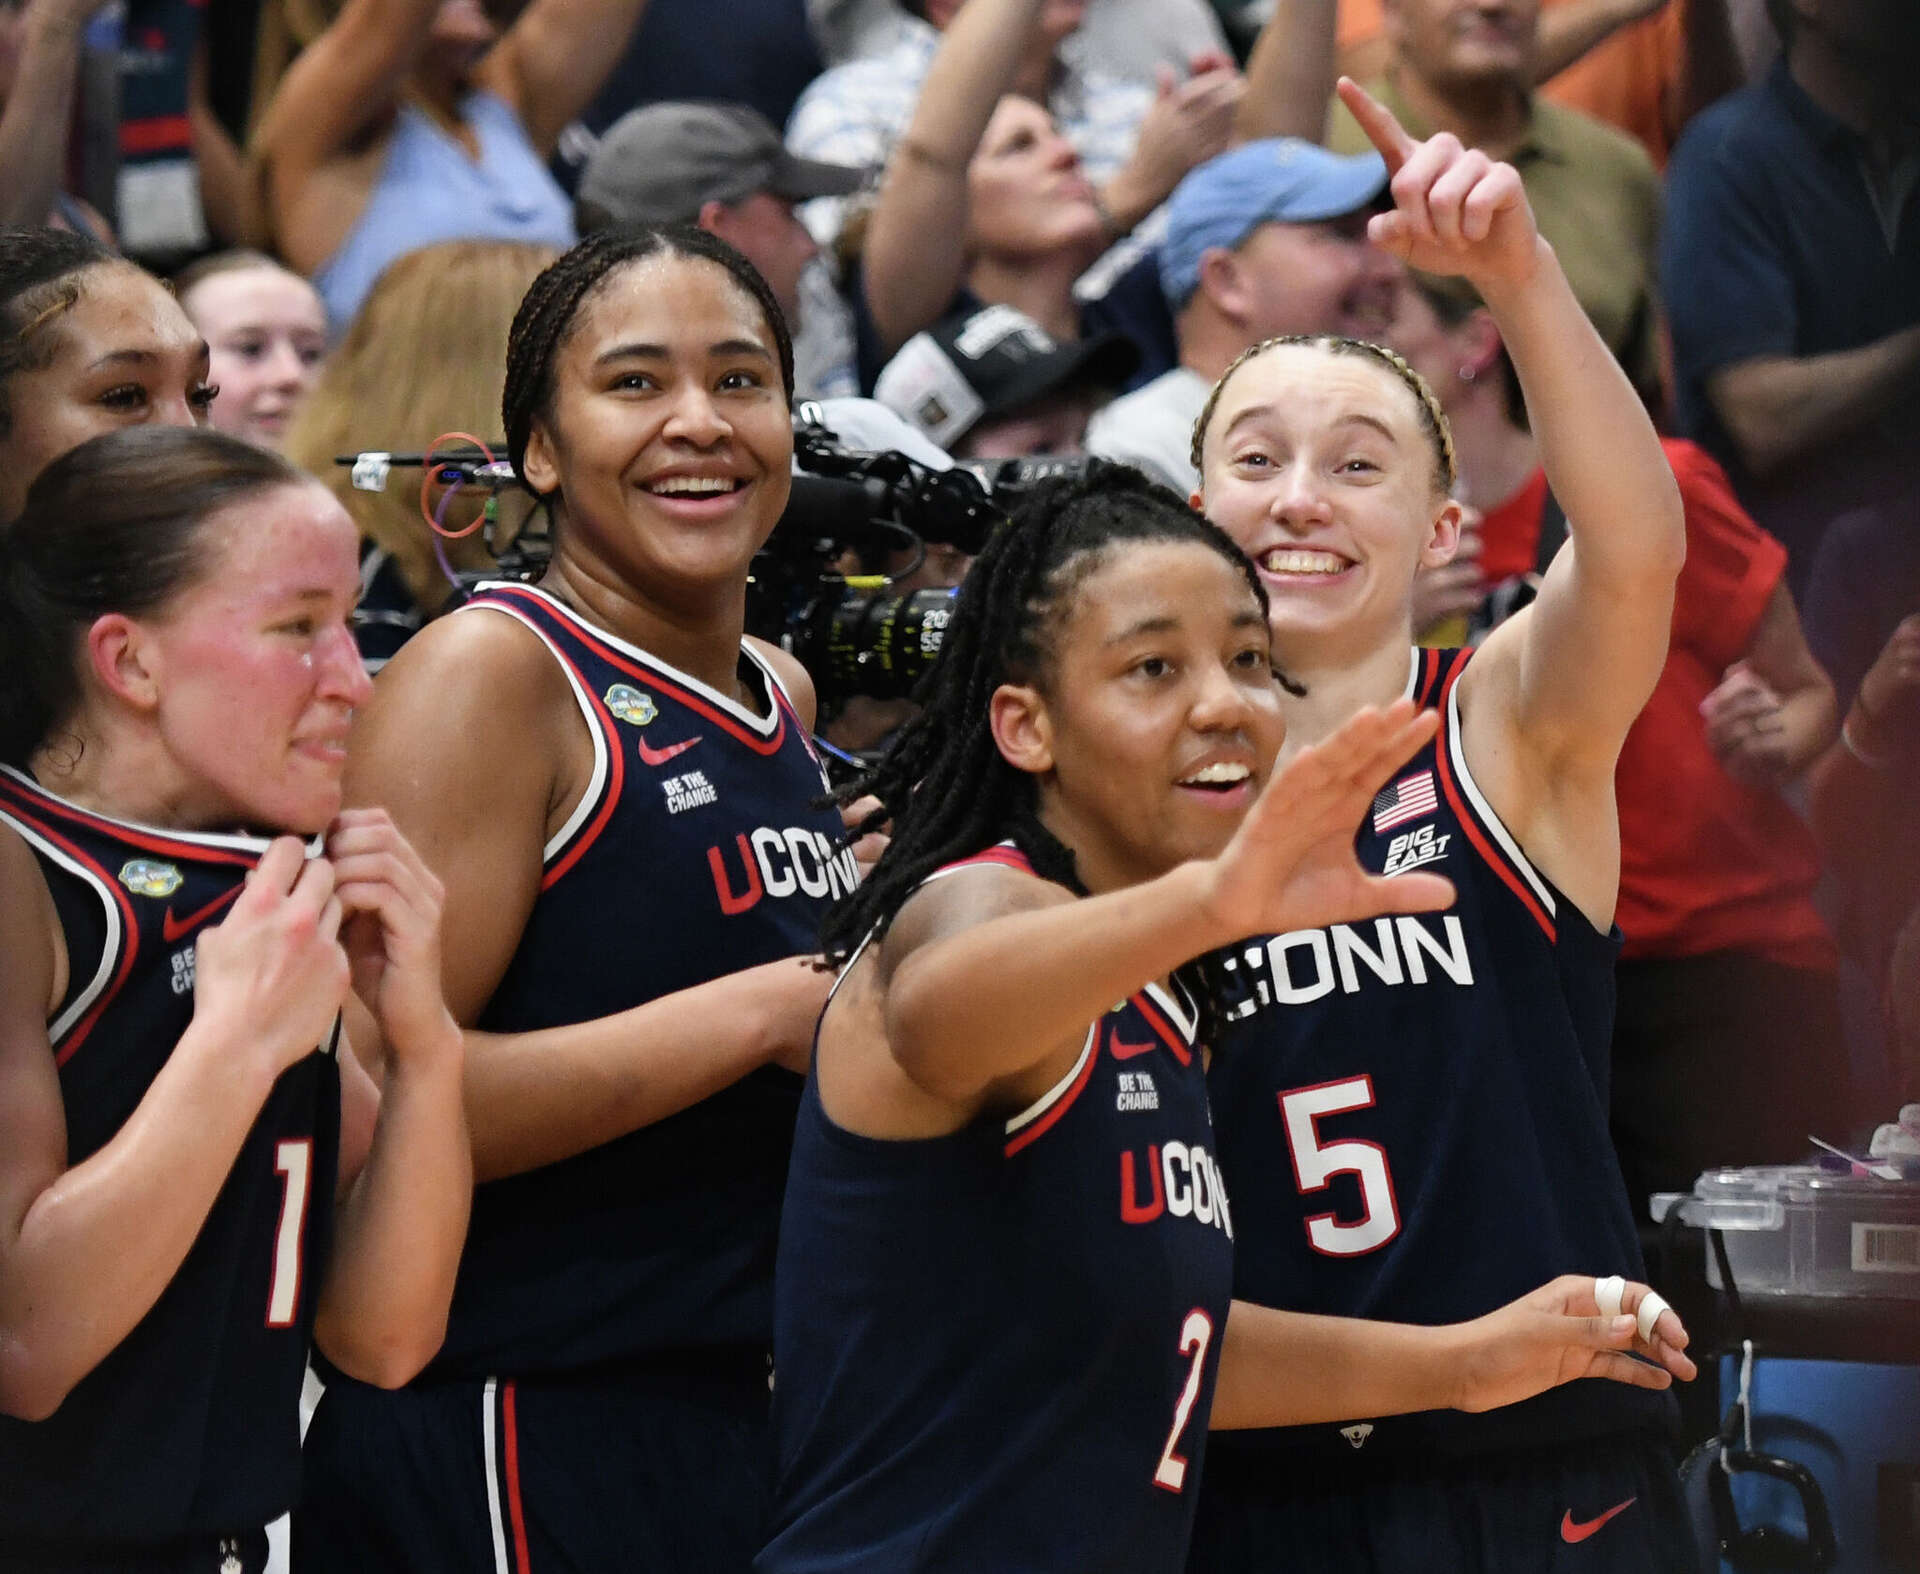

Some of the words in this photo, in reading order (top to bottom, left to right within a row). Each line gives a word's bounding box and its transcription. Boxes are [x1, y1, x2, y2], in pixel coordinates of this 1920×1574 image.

[662, 776, 684, 796] BE
[680, 770, 708, 790] THE
[666, 784, 718, 815] CHANGE
[1383, 834, 1451, 874] EAST
[1387, 824, 1435, 857] BIG
[171, 947, 196, 973] BE
[1118, 1073, 1136, 1092] BE
[1137, 1073, 1155, 1091] THE
[1117, 1091, 1159, 1111] CHANGE
[1277, 1073, 1401, 1258] 5
[1120, 1140, 1233, 1240] UCON
[265, 1136, 314, 1328] 1
[1153, 1307, 1214, 1493] 2
